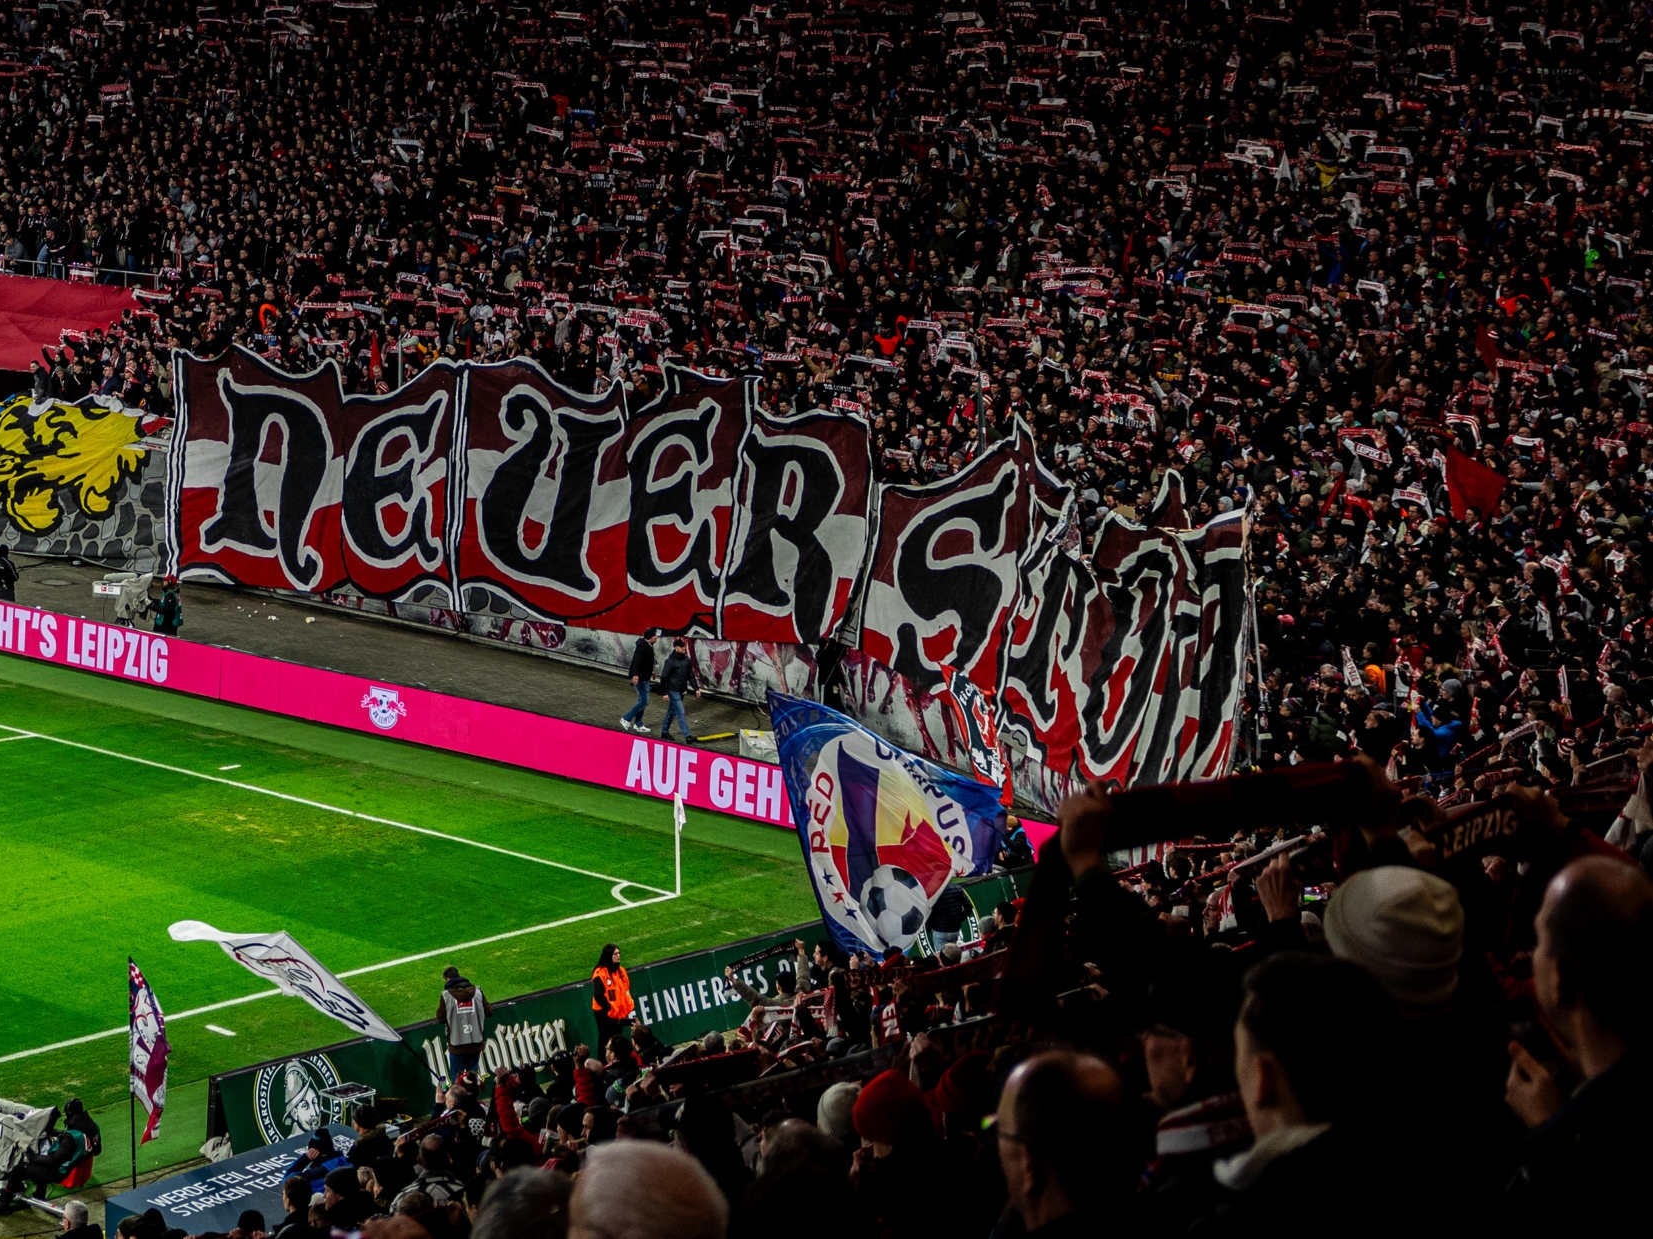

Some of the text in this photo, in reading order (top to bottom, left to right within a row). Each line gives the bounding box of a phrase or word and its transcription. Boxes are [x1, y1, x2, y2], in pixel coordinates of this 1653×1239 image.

[200, 366, 848, 643] NEUER
[67, 620, 169, 683] LEIPZIG
[625, 738, 796, 824] AUF GEH
[147, 1153, 298, 1208] WERDE TEIL EINES
[170, 1186, 252, 1217] STARKEN
